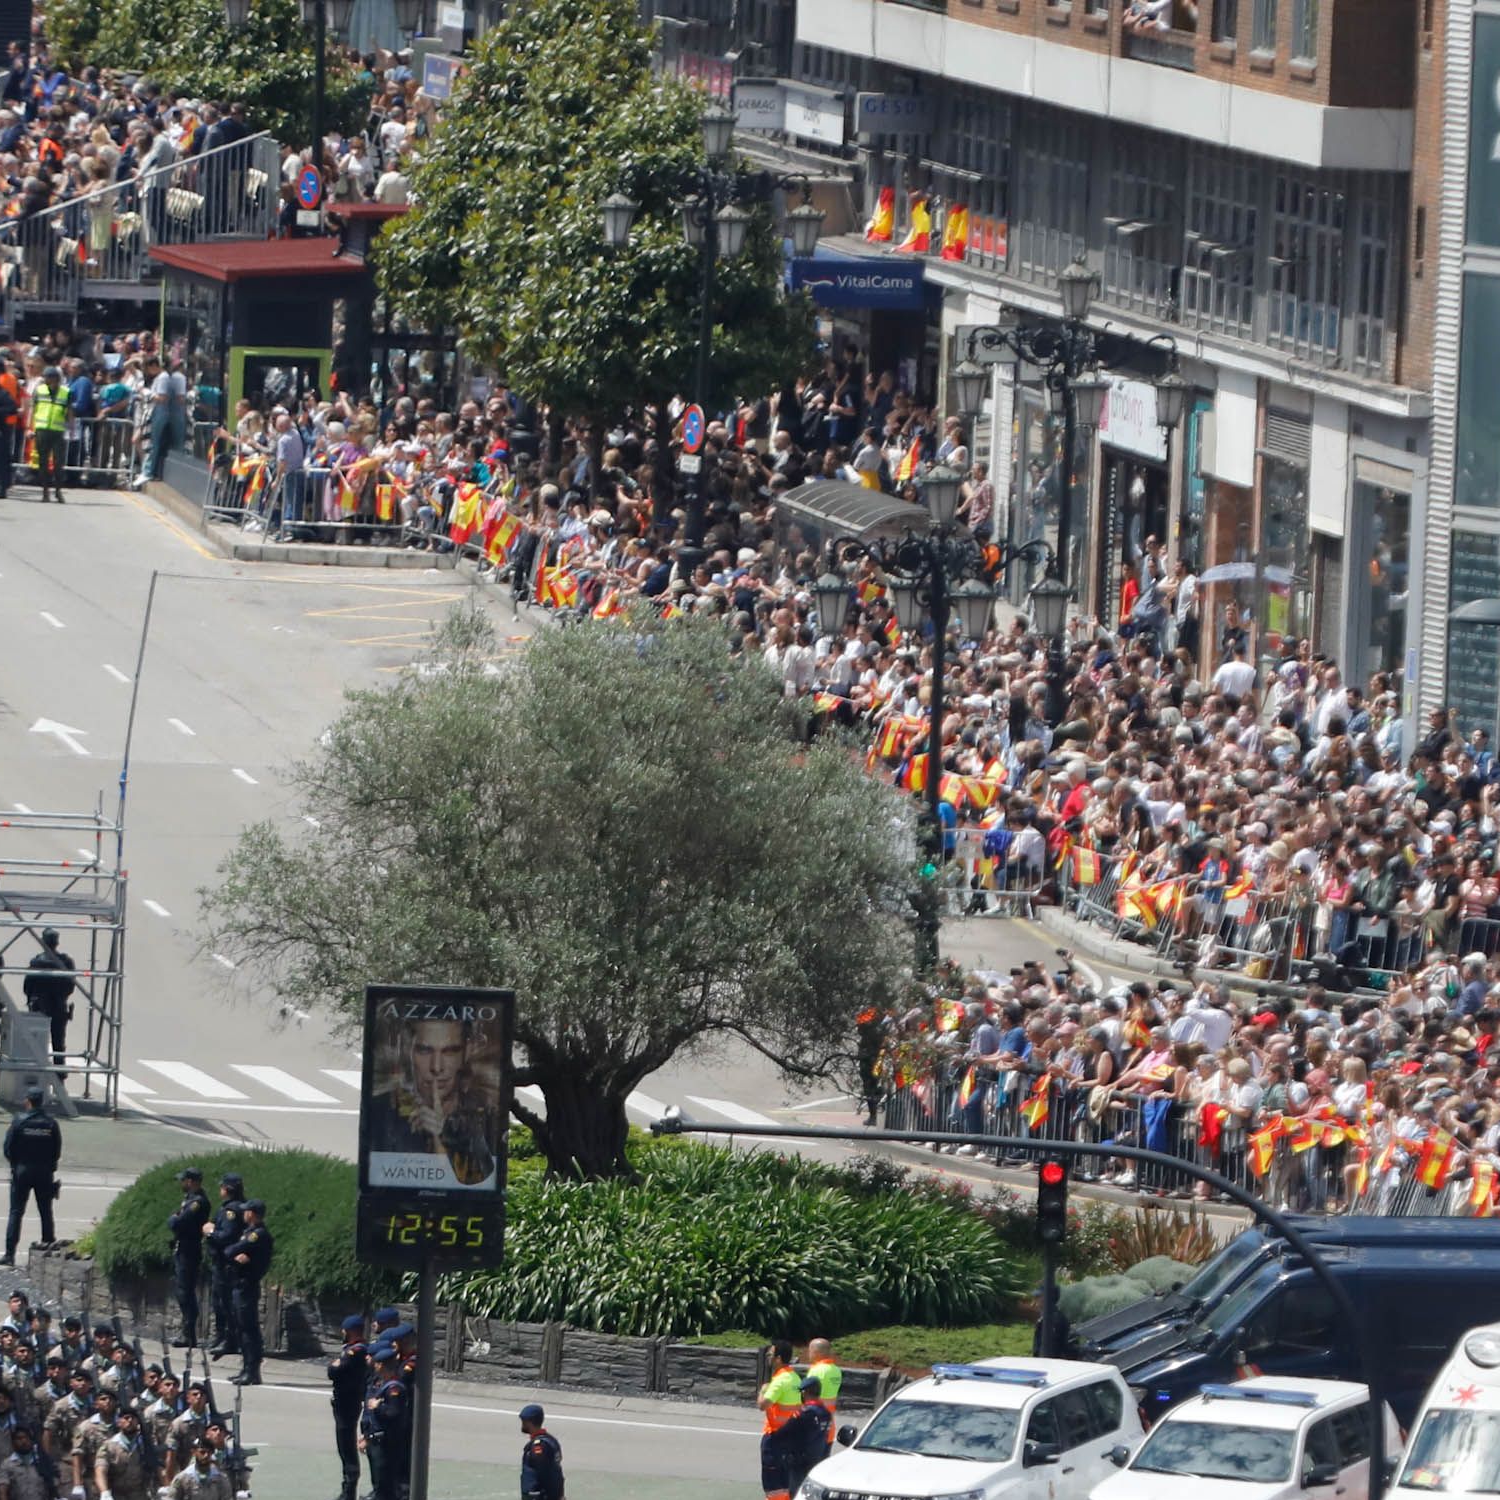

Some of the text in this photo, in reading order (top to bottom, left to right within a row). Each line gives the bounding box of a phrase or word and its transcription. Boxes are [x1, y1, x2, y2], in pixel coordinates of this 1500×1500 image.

[837, 274, 913, 289] VitalCama
[384, 1002, 498, 1022] AZZARO
[382, 1167, 445, 1180] WANTED
[388, 1214, 484, 1246] 12:55
